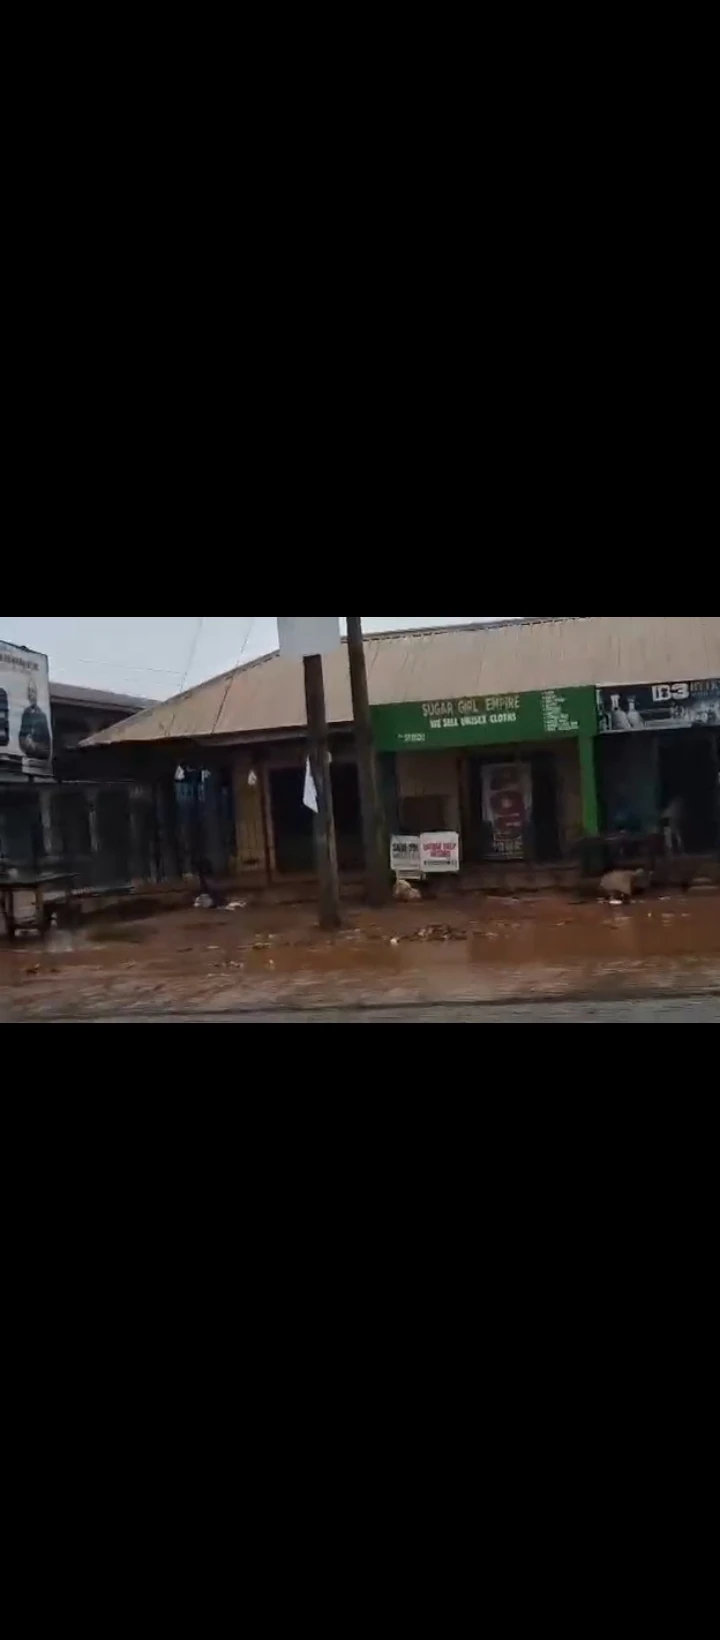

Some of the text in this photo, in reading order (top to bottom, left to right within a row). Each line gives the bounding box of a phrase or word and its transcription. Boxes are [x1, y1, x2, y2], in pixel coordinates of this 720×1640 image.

[422, 695, 520, 717] SUGAR GIRL EMPIRE
[430, 719, 441, 729] WE
[443, 717, 458, 728] SELL
[460, 715, 487, 727] UNISEX
